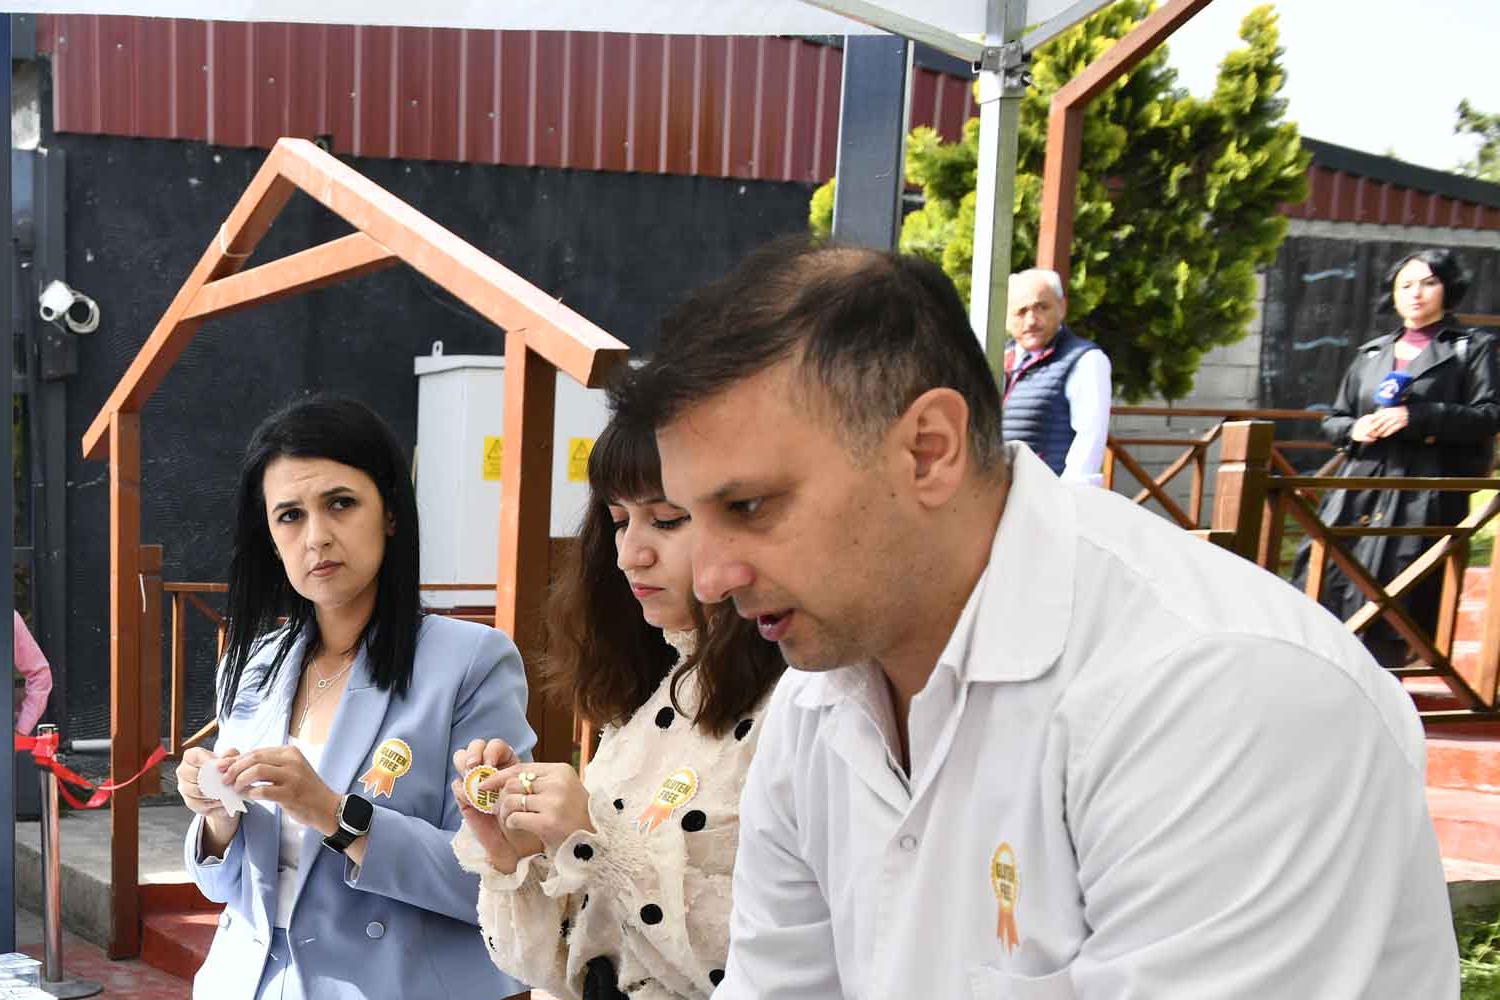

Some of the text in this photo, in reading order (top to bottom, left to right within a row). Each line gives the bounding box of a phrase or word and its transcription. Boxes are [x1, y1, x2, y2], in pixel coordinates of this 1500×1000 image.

[378, 746, 409, 768] GLUTEN
[378, 756, 400, 774] FREE
[657, 788, 679, 806] FREE
[662, 778, 692, 798] GLUTEN
